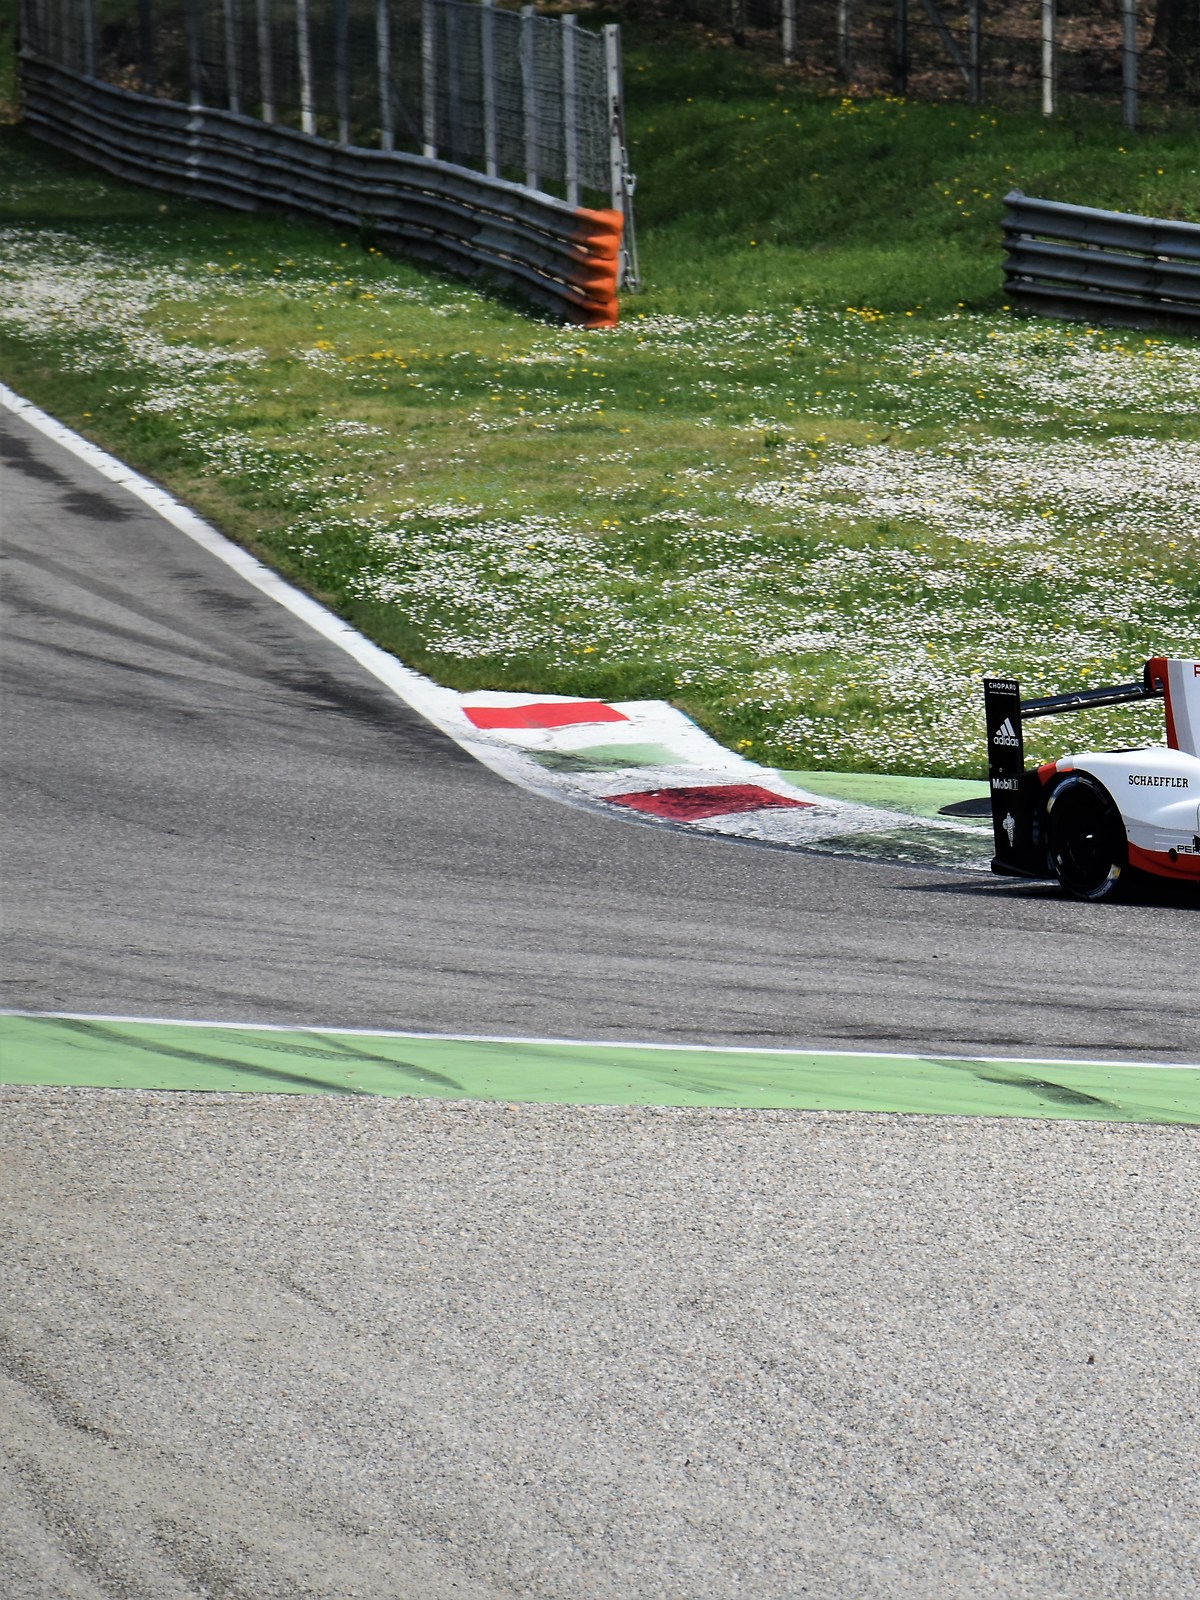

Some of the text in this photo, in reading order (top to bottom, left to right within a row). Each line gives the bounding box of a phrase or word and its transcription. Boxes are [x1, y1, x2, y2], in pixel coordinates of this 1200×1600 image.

[988, 682, 1017, 691] CHOPARD
[993, 734, 1019, 747] adidas
[1128, 775, 1189, 788] SCHAEFFLER
